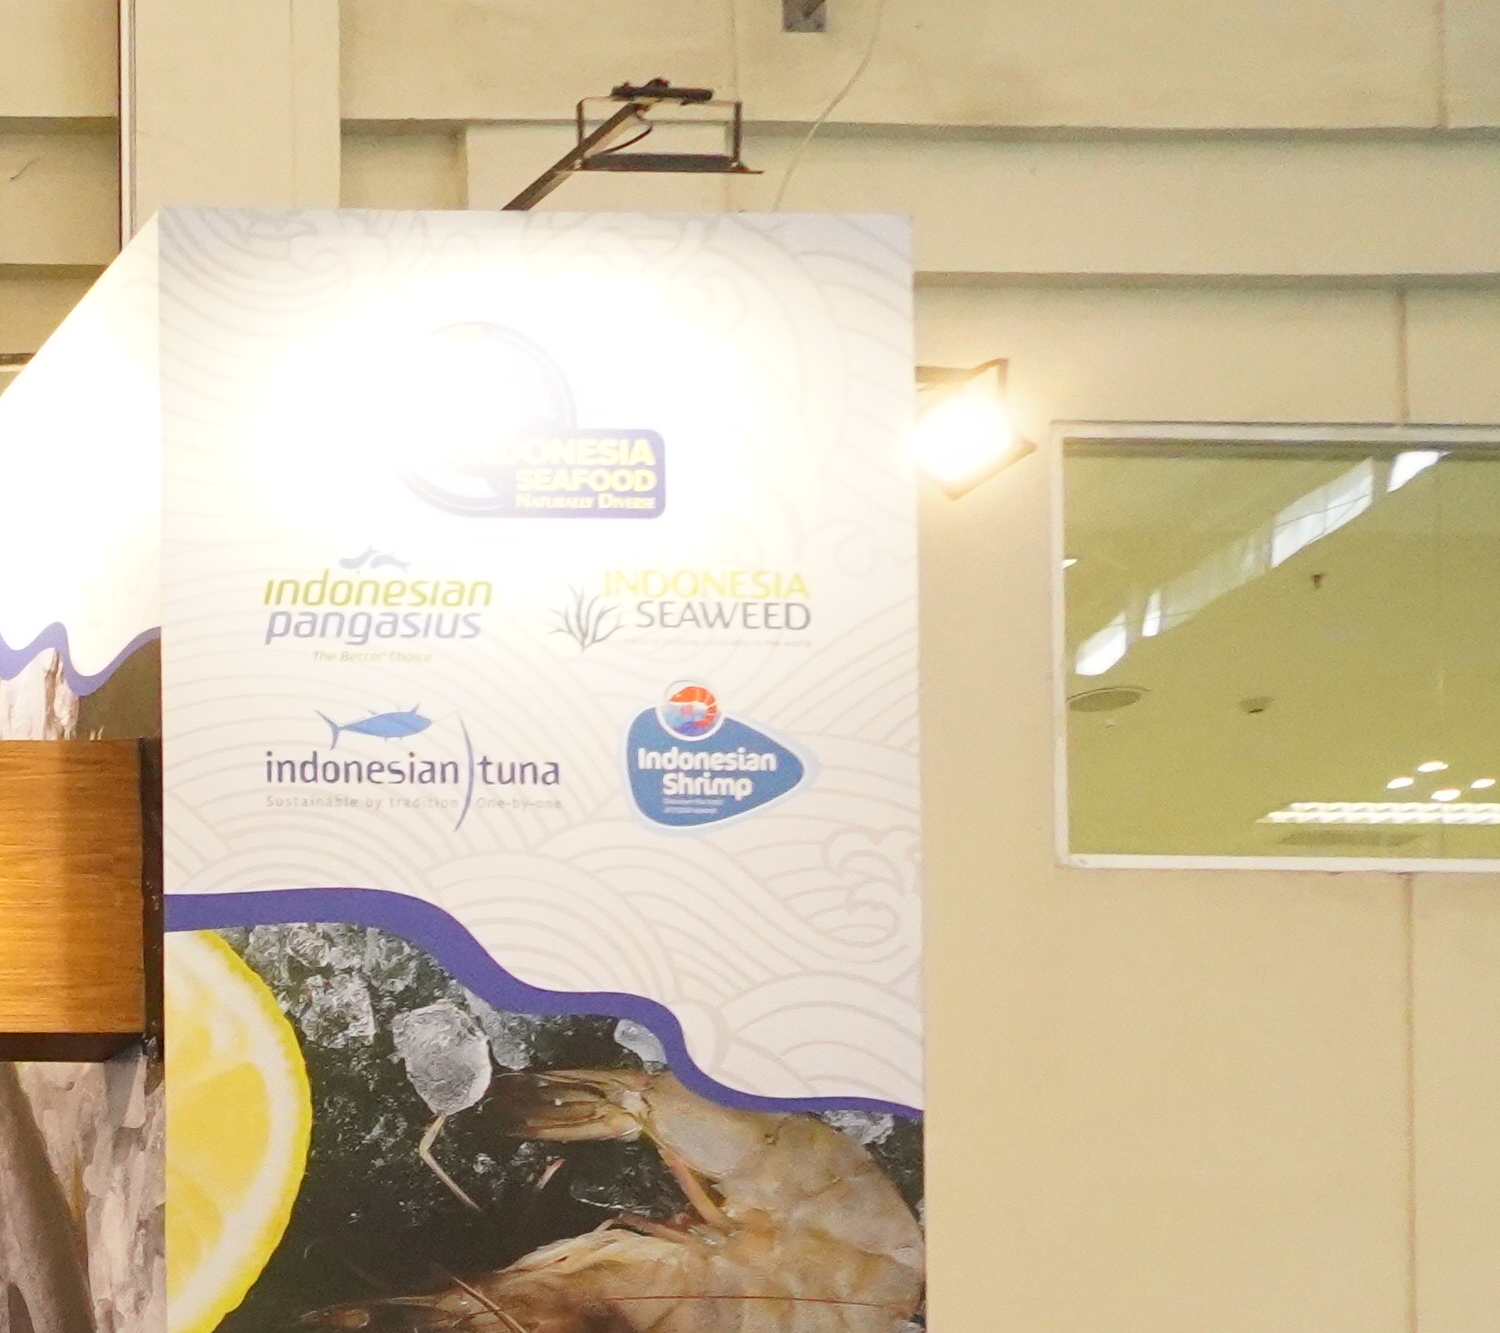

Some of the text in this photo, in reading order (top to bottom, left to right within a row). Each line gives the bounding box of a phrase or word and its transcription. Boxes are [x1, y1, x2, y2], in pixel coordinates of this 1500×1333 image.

[516, 469, 658, 493] SEAFOOD
[263, 568, 493, 607] indonesian
[603, 570, 811, 600] INDONESIA
[264, 611, 482, 646] pangasius
[636, 601, 811, 631] SEAWEED
[312, 651, 338, 663] The
[265, 751, 560, 786] indonesian tuna
[637, 746, 778, 772] Indonesian
[662, 771, 754, 801] Shrimp
[266, 795, 357, 808] Sustainable
